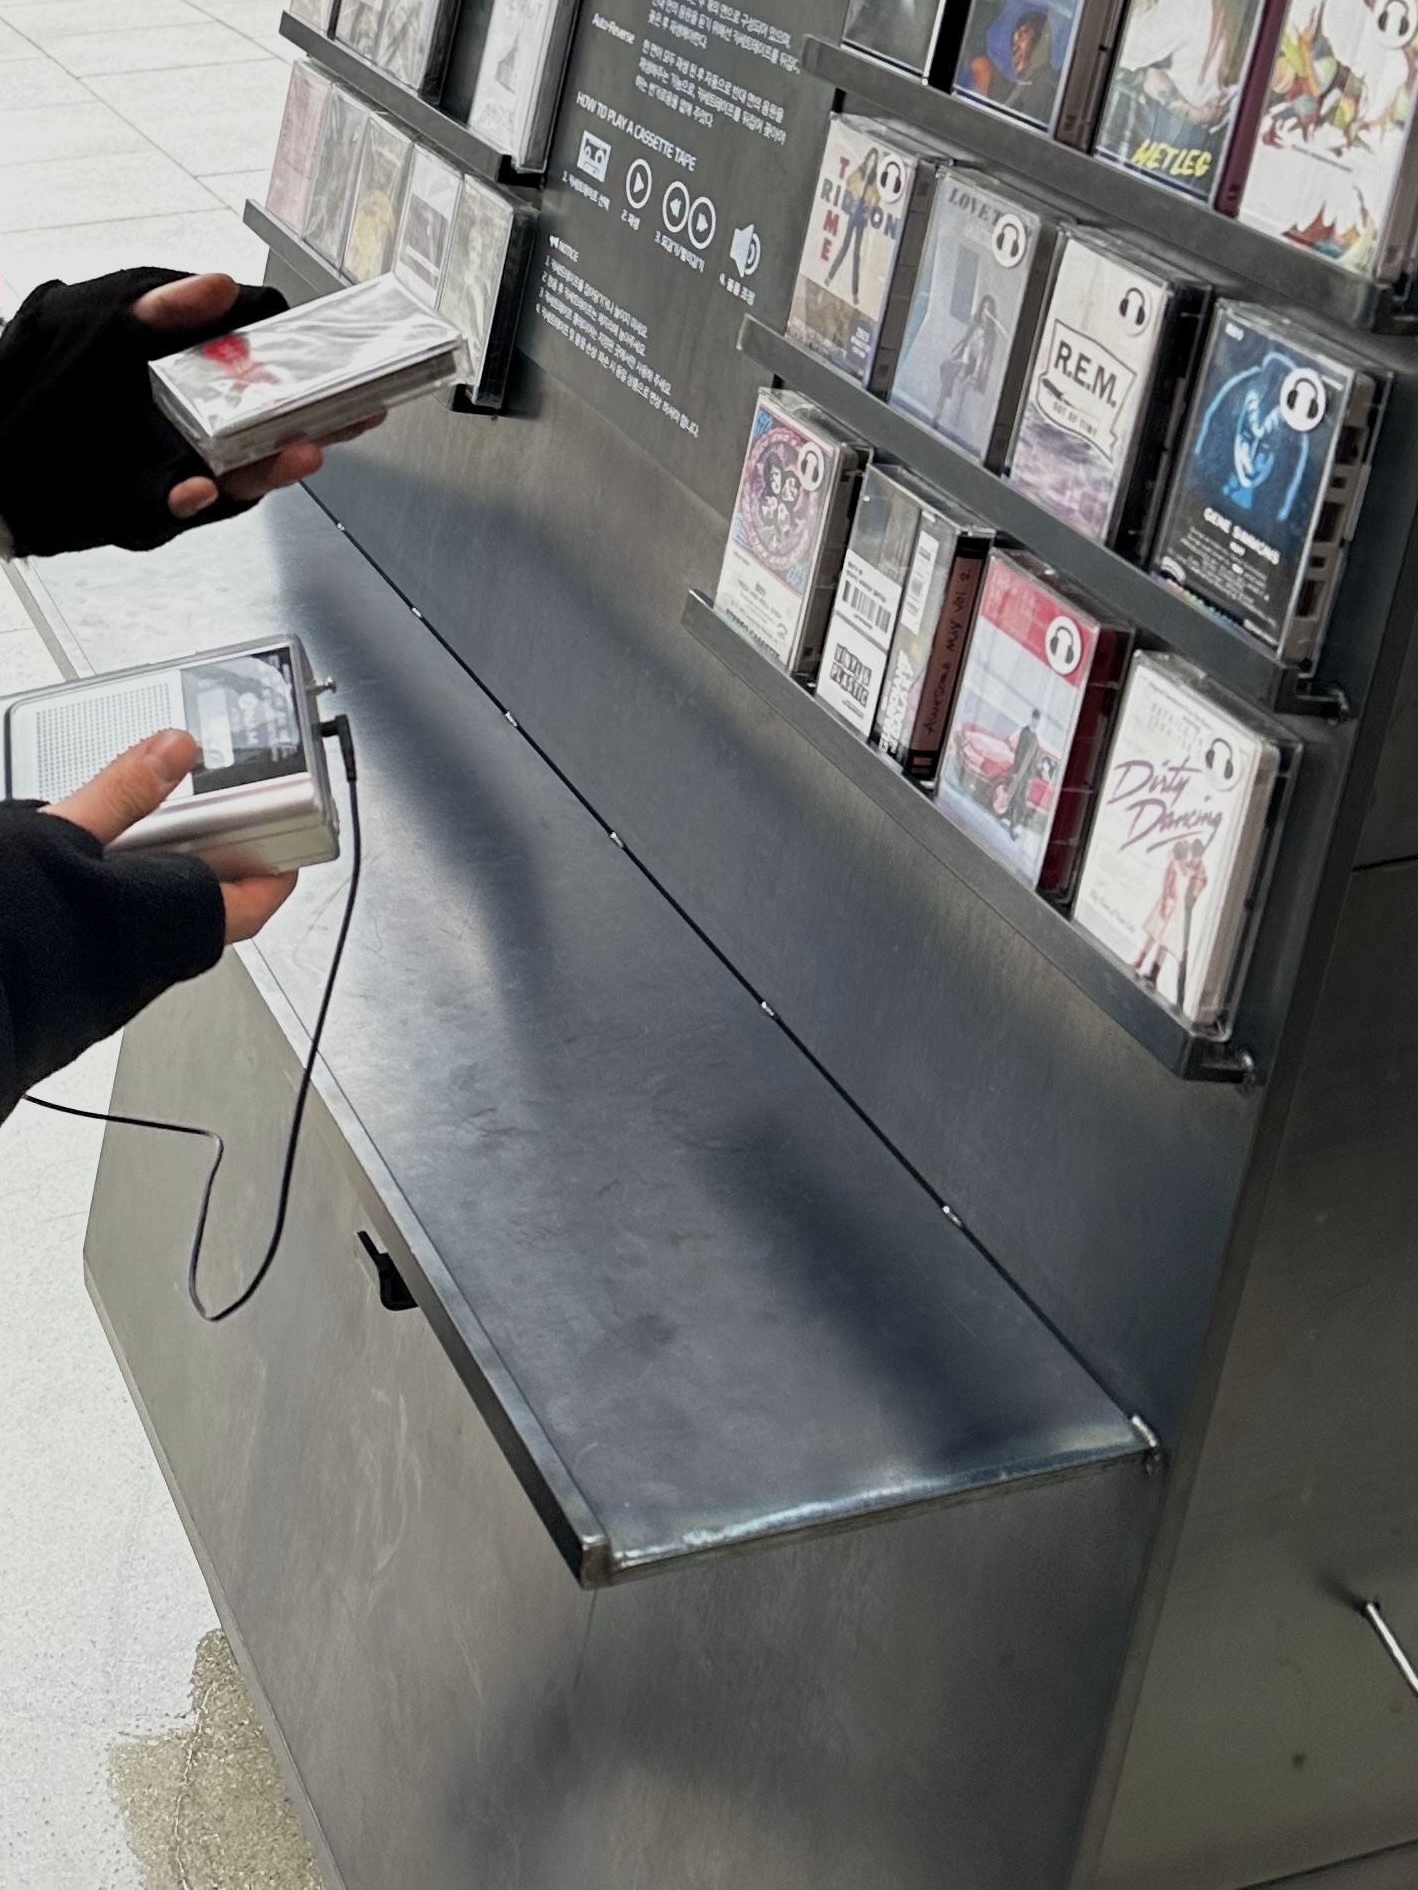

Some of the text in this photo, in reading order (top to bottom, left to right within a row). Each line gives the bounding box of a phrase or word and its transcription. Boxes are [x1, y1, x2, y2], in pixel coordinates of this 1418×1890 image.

[592, 12, 634, 44] Auto-Reverse
[661, 15, 669, 31] 후
[678, 4, 697, 25] 음원을
[732, 29, 778, 63] 카세트테이프를
[719, 3, 740, 25] 면으로
[740, 12, 768, 37] 구성되어
[635, 74, 648, 93] 하는
[648, 82, 678, 109] 번거로움을
[639, 56, 669, 84] 재생해주는
[696, 86, 740, 122] 카세트테이프를
[741, 110, 763, 133] 뒤집어
[642, 39, 784, 123] 한 면이 모두 재생 된 후 자동으로 반대 면의 음원을
[576, 91, 696, 171] HOW TO PLAY A CASSETTE TAPE
[559, 240, 578, 263] NOTICE
[1054, 339, 1117, 408] R.E.M.
[829, 660, 869, 708] PLASTIC
[1107, 756, 1202, 805] Dirty
[1118, 795, 1222, 856] Dancing
